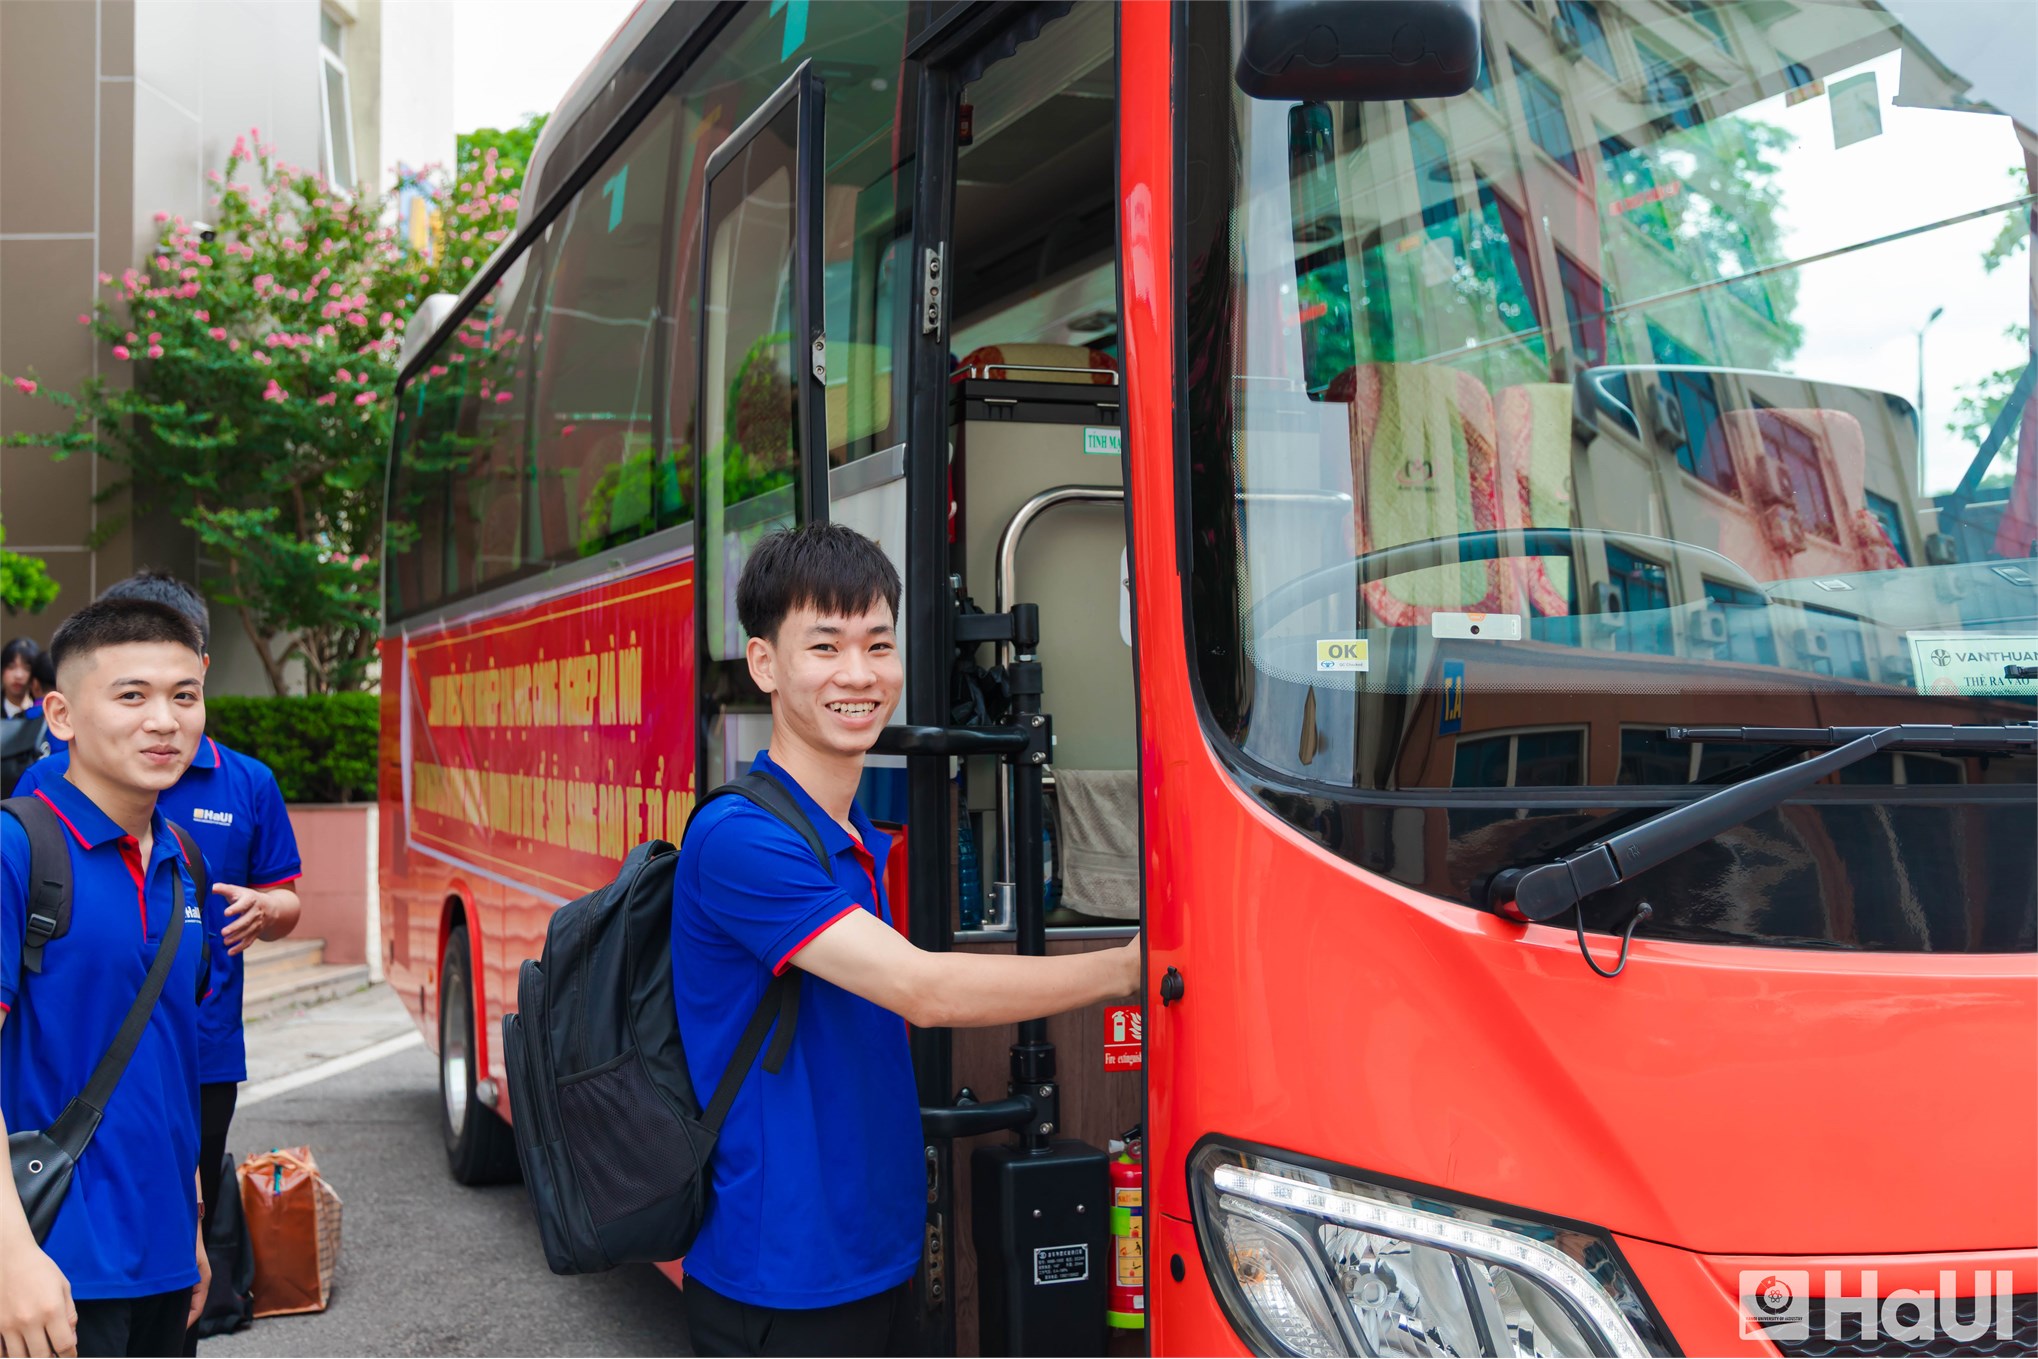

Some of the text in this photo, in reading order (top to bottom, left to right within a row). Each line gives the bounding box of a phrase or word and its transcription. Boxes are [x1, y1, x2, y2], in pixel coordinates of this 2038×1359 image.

[1328, 644, 1358, 659] OK
[619, 629, 642, 744] NỘI
[1990, 676, 2004, 686] RA
[599, 758, 624, 862] BẢO
[646, 755, 664, 842] TỔ
[204, 809, 233, 824] HaUI
